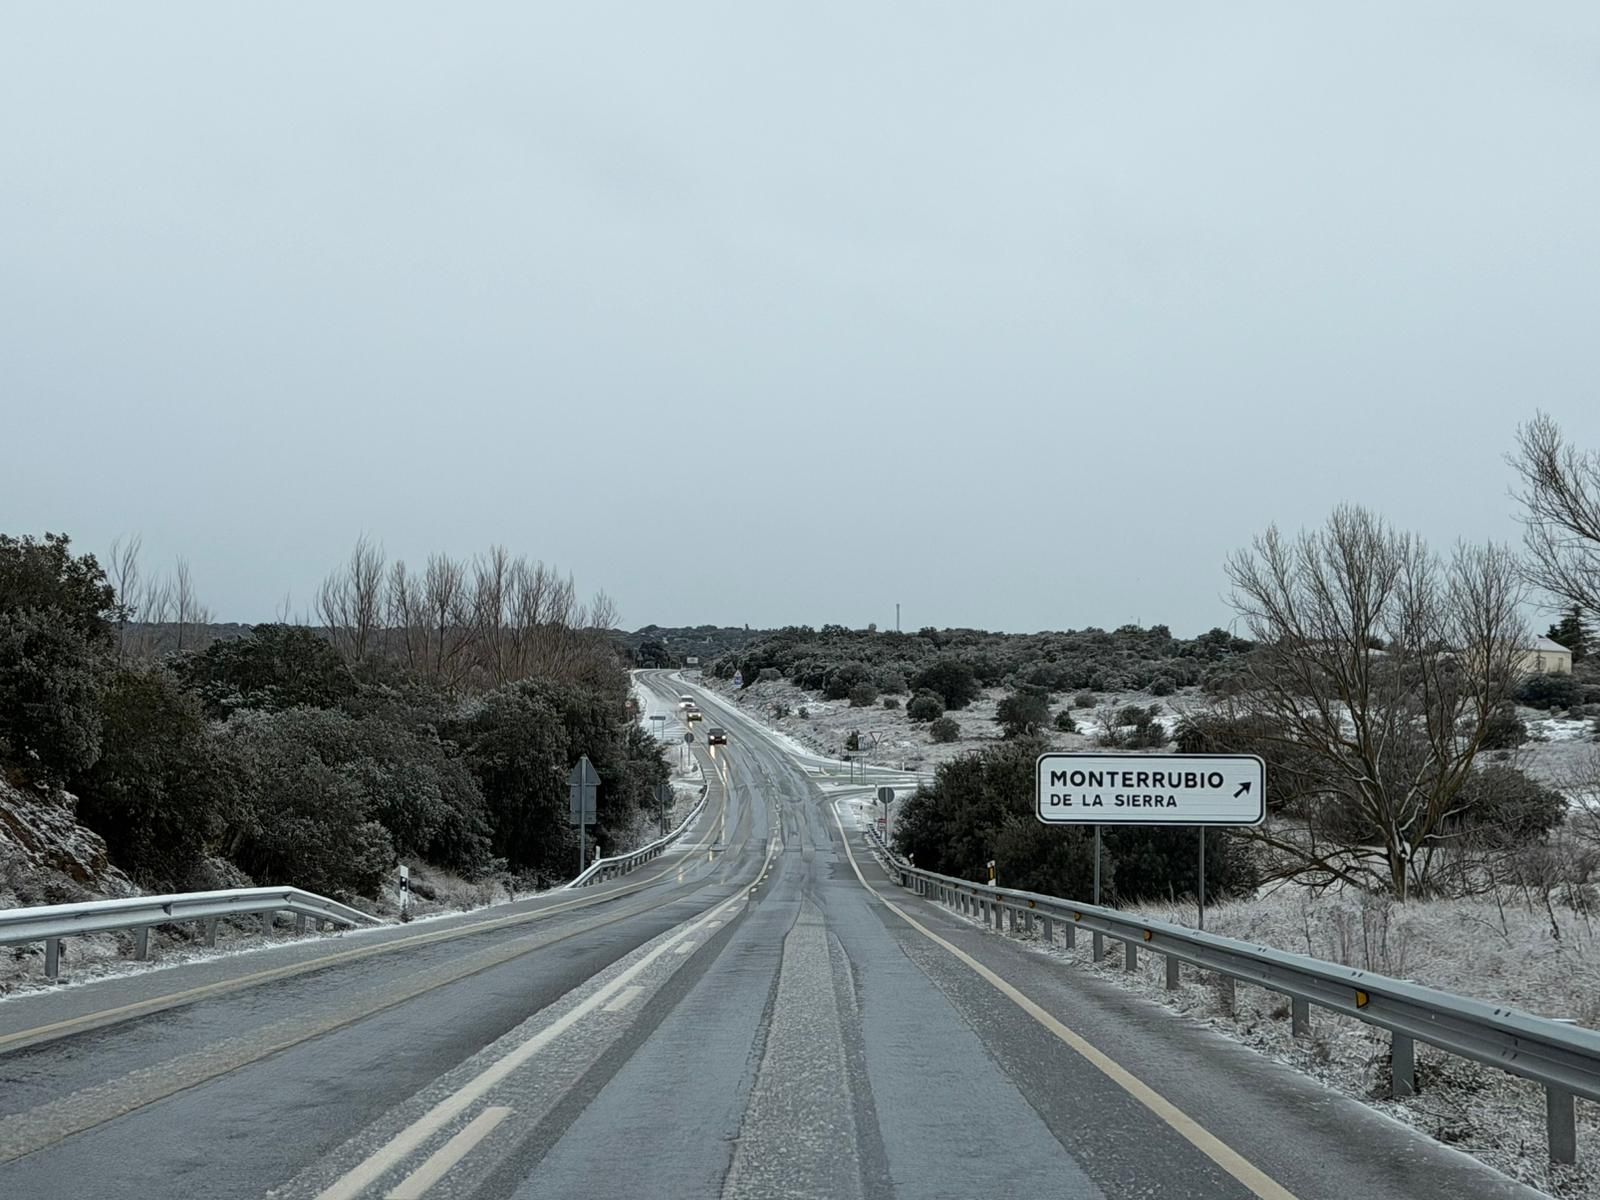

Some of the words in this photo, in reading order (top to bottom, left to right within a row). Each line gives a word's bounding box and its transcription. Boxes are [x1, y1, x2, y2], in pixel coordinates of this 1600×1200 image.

[1050, 770, 1224, 789] MONTERRUBIO
[1050, 793, 1072, 807] DE
[1082, 793, 1103, 807] LA
[1114, 794, 1177, 808] SIERRA
